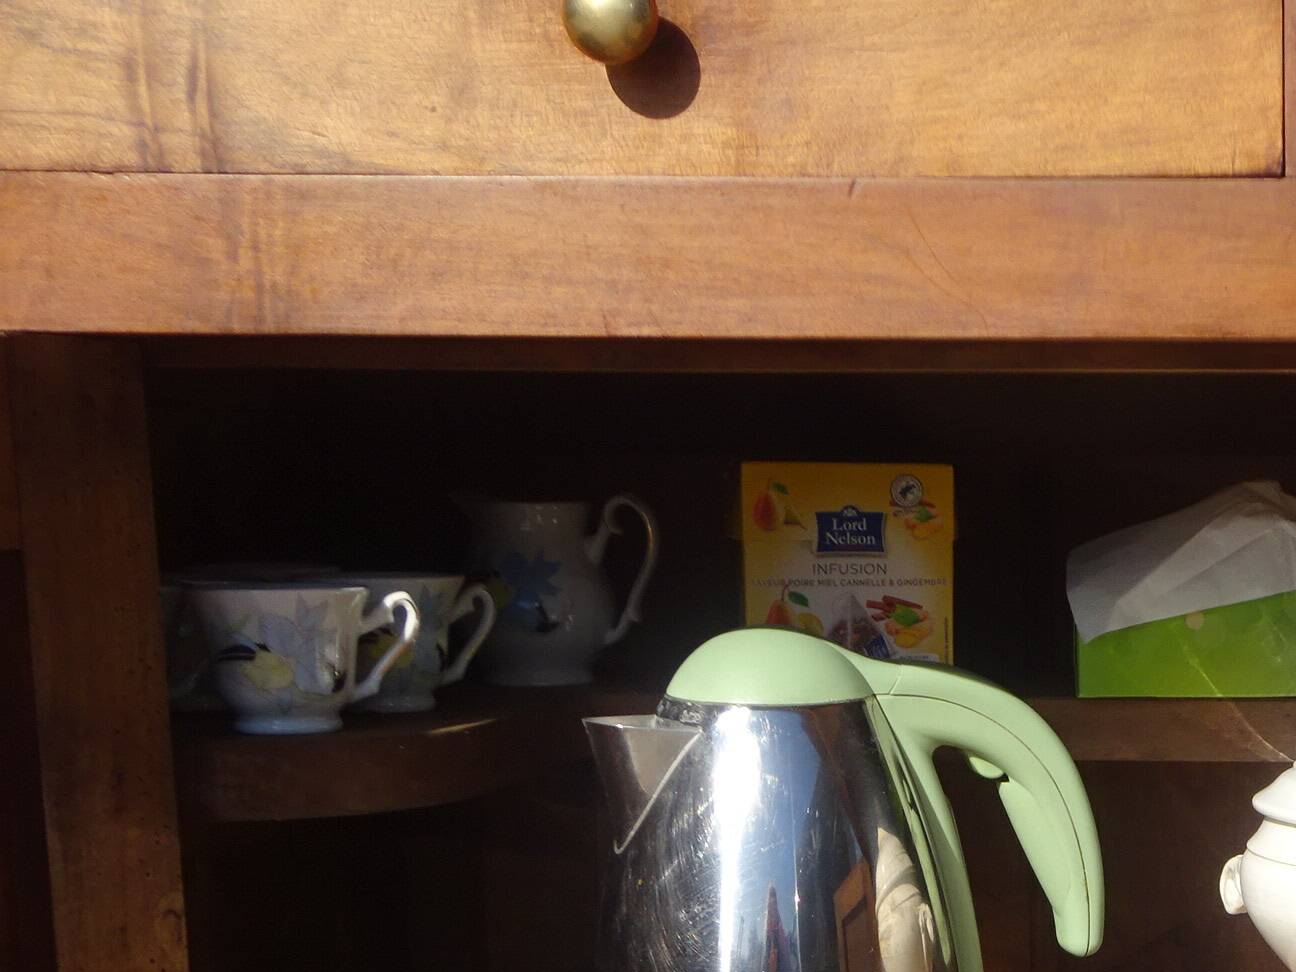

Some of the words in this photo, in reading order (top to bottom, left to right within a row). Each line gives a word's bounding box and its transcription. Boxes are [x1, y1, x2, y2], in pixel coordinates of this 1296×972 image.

[832, 517, 867, 532] Lord
[825, 532, 876, 545] Nelson
[812, 562, 888, 575] INFUSION
[840, 578, 885, 587] CANNELLE
[897, 577, 948, 587] GINGEMBRE
